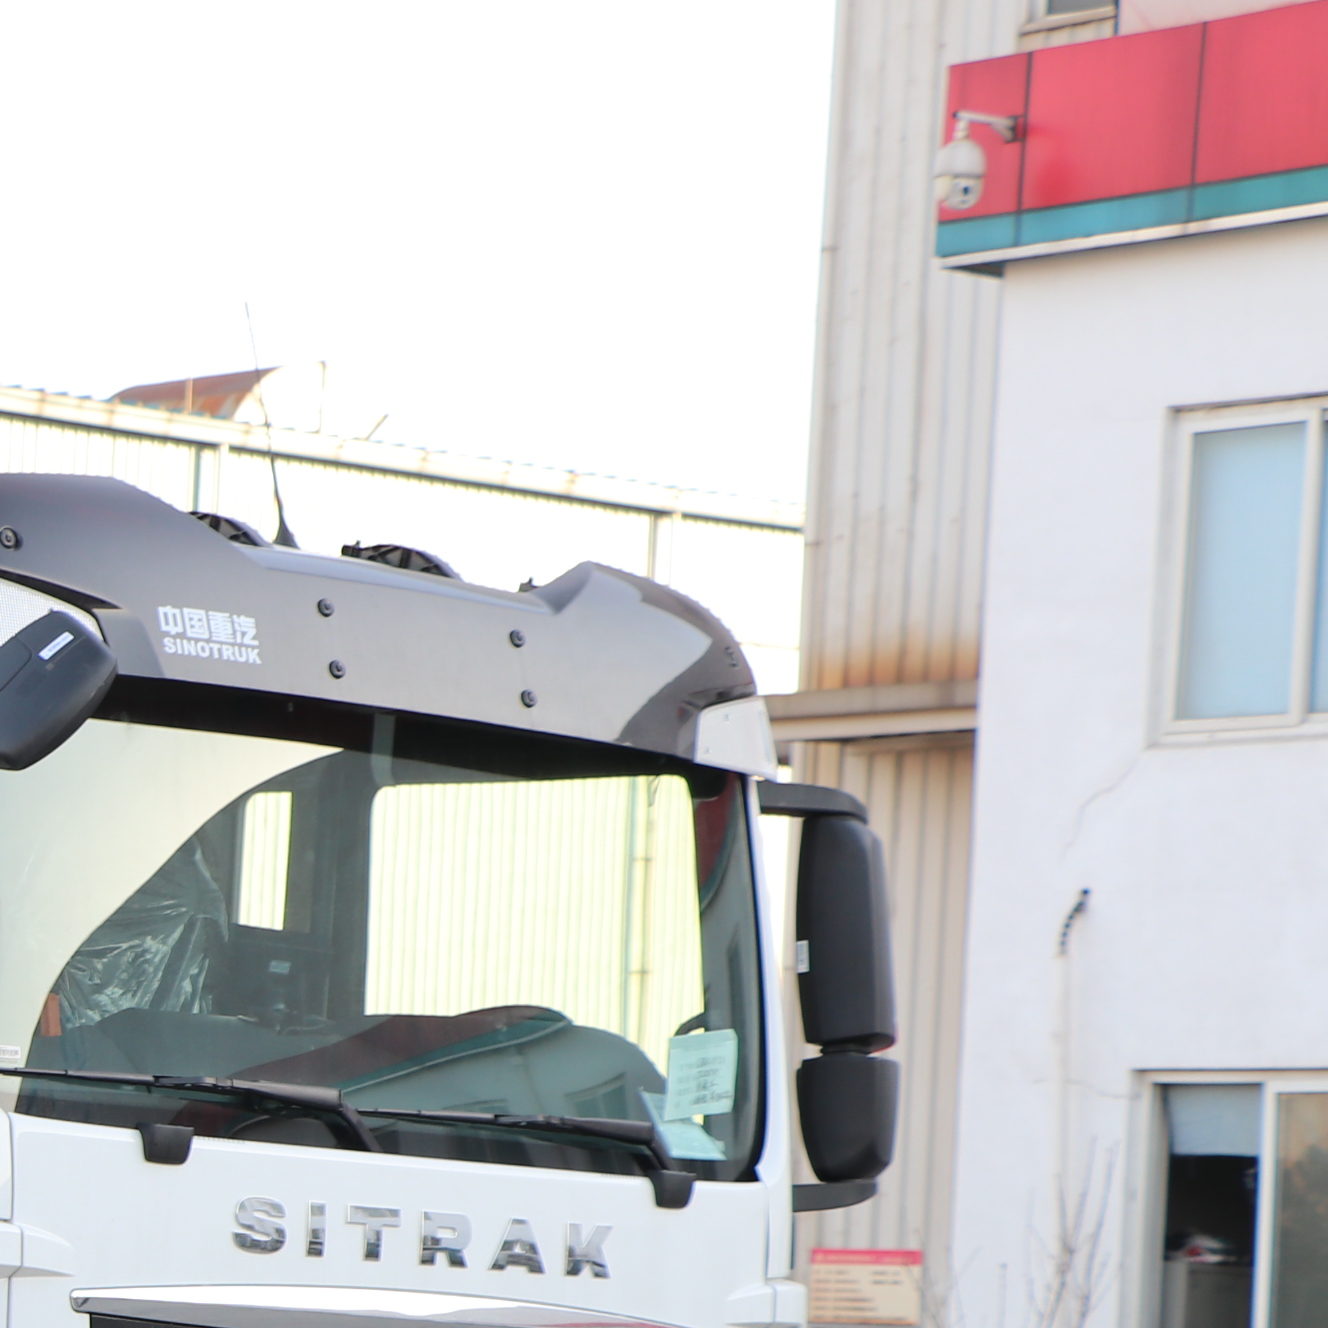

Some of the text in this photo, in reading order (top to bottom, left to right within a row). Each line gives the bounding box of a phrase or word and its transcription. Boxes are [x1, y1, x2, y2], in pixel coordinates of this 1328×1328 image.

[157, 605, 259, 646] 中国重汽
[163, 637, 262, 665] SINOTRUK
[231, 1195, 614, 1279] SITRAK
